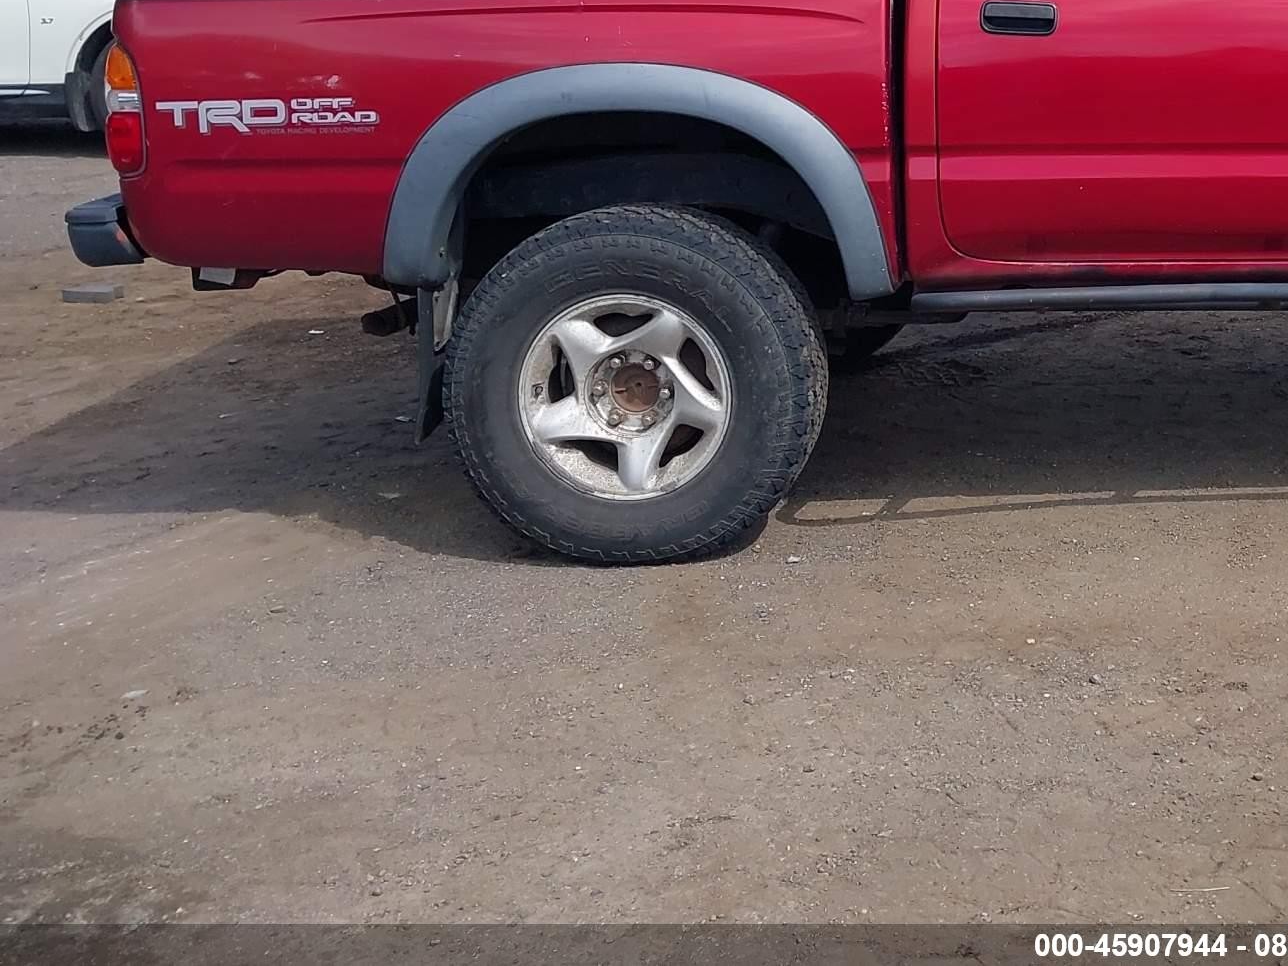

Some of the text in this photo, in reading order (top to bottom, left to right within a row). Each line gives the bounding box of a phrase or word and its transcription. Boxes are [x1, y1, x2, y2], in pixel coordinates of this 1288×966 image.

[290, 97, 355, 110] OFF
[155, 98, 287, 135] TRD
[290, 110, 380, 125] ROAD
[256, 127, 285, 135] TOYOTA
[319, 126, 376, 134] DEVELOPMENT
[546, 259, 733, 334] GENERAL
